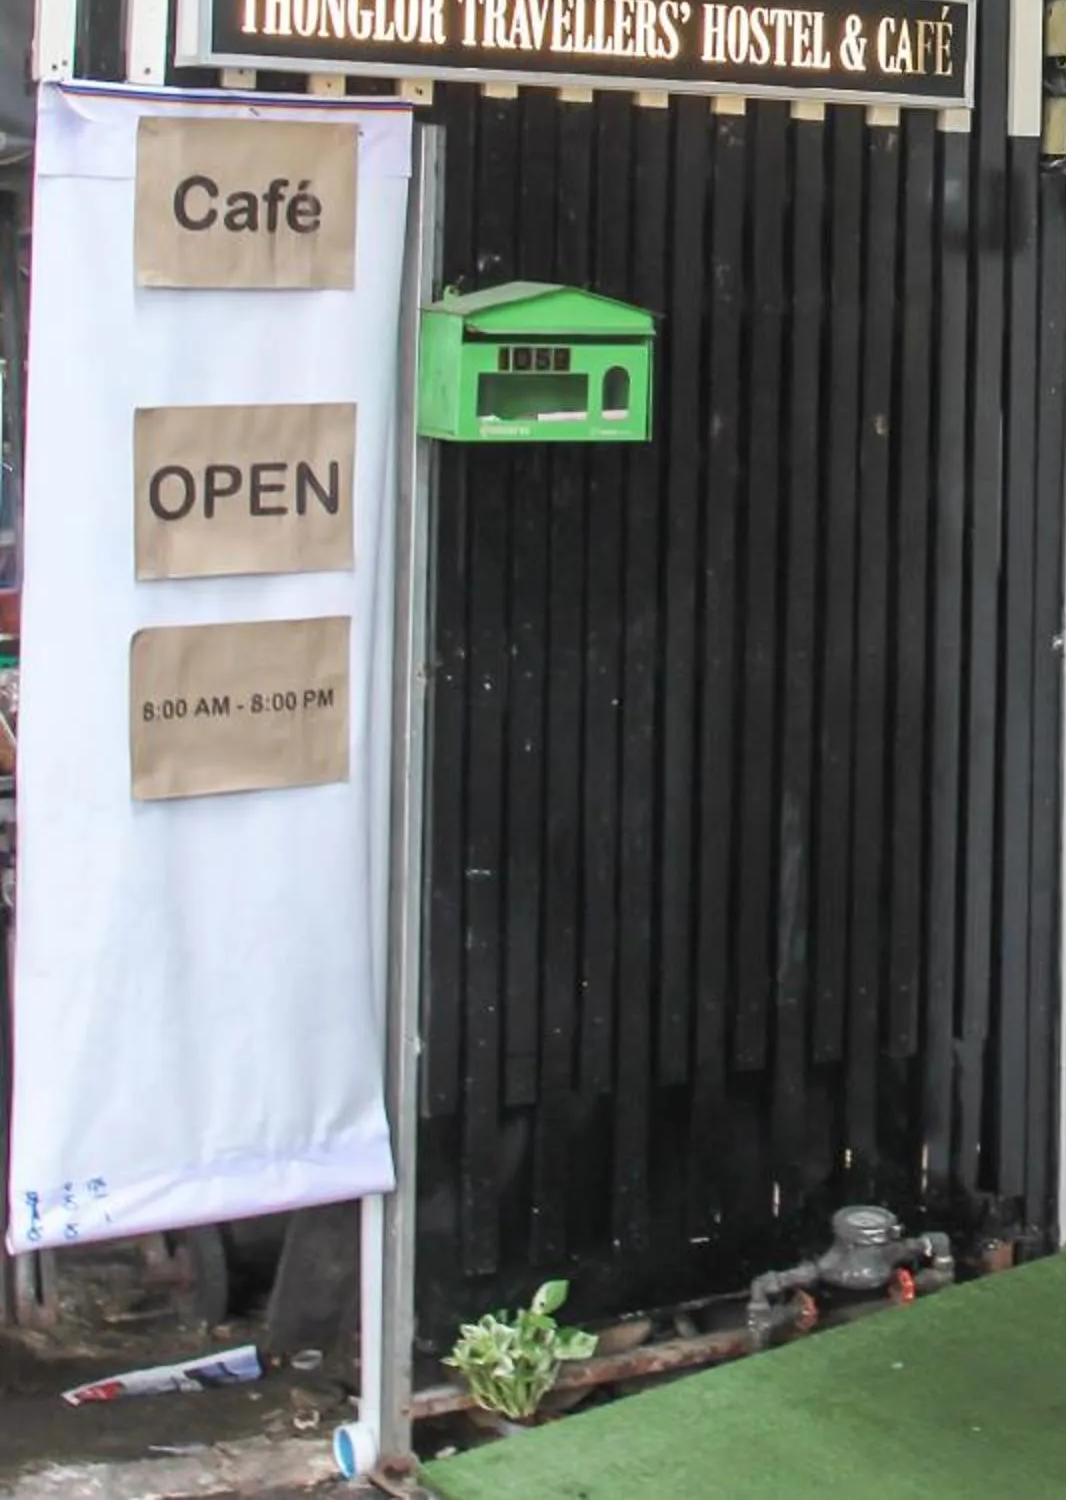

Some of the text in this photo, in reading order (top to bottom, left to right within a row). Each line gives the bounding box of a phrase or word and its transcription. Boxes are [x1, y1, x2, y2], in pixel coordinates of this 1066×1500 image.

[701, 3, 832, 70] HOSTEL
[840, 14, 867, 72] &
[877, 5, 953, 76] CAFÉ
[174, 175, 322, 233] Café
[149, 460, 340, 522] OPEN
[143, 699, 187, 722] 8:00
[194, 695, 231, 718] AM
[250, 691, 297, 714] 8:00
[303, 688, 334, 709] PM
